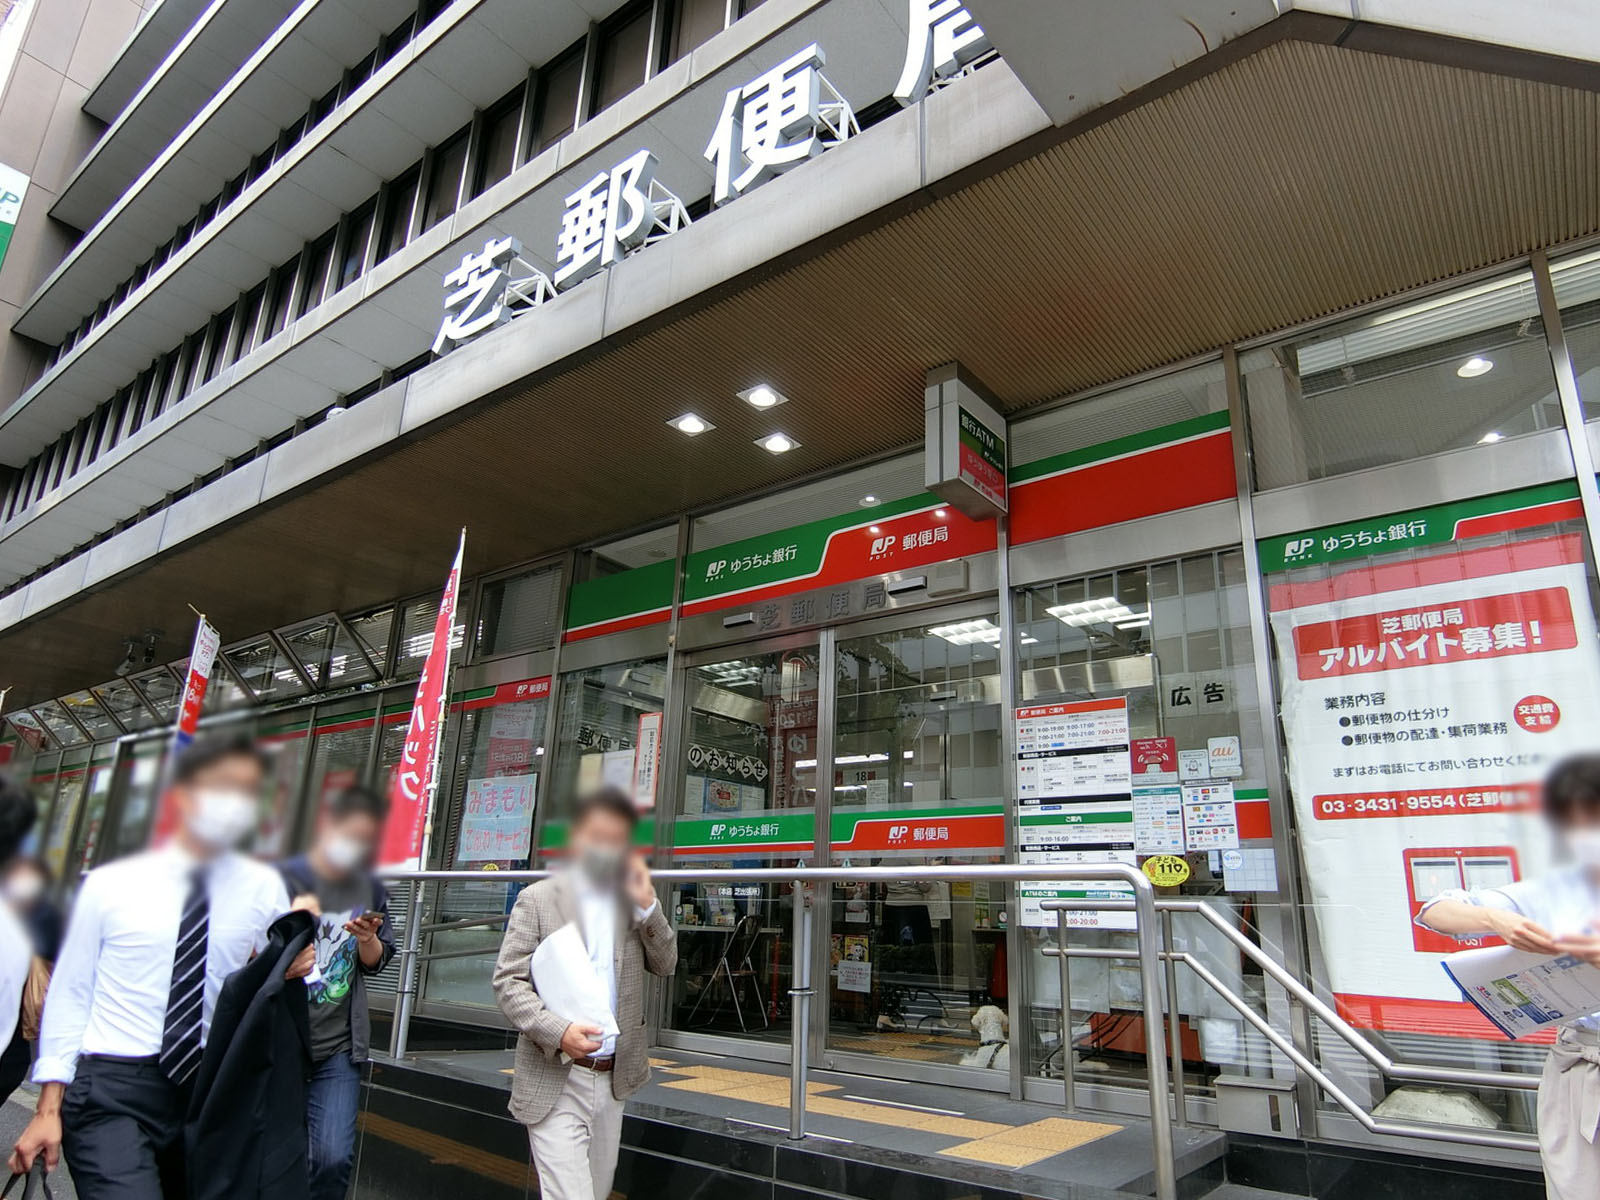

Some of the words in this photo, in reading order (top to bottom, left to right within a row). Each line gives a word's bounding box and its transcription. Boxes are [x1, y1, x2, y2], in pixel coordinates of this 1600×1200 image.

[902, 526, 949, 551] 郵便局
[1322, 519, 1428, 553] ゆうちょ銀行
[730, 544, 798, 574] ゆうちょ銀行
[760, 581, 887, 631] 芝郵便局
[1381, 607, 1464, 634] 芝郵便局
[1318, 619, 1543, 672] アルバイト募集!
[1171, 682, 1225, 707] 広告
[1324, 692, 1386, 710] 業務内容
[1351, 706, 1450, 726] 郵便物の仕分け
[1354, 721, 1508, 746] 郵便物の配達・集荷業務
[690, 748, 765, 777] のお知らせ
[1211, 747, 1234, 757] au
[468, 784, 533, 814] みまもり
[729, 823, 780, 837] ゆうちょ銀行
[913, 827, 949, 841] 郵便局
